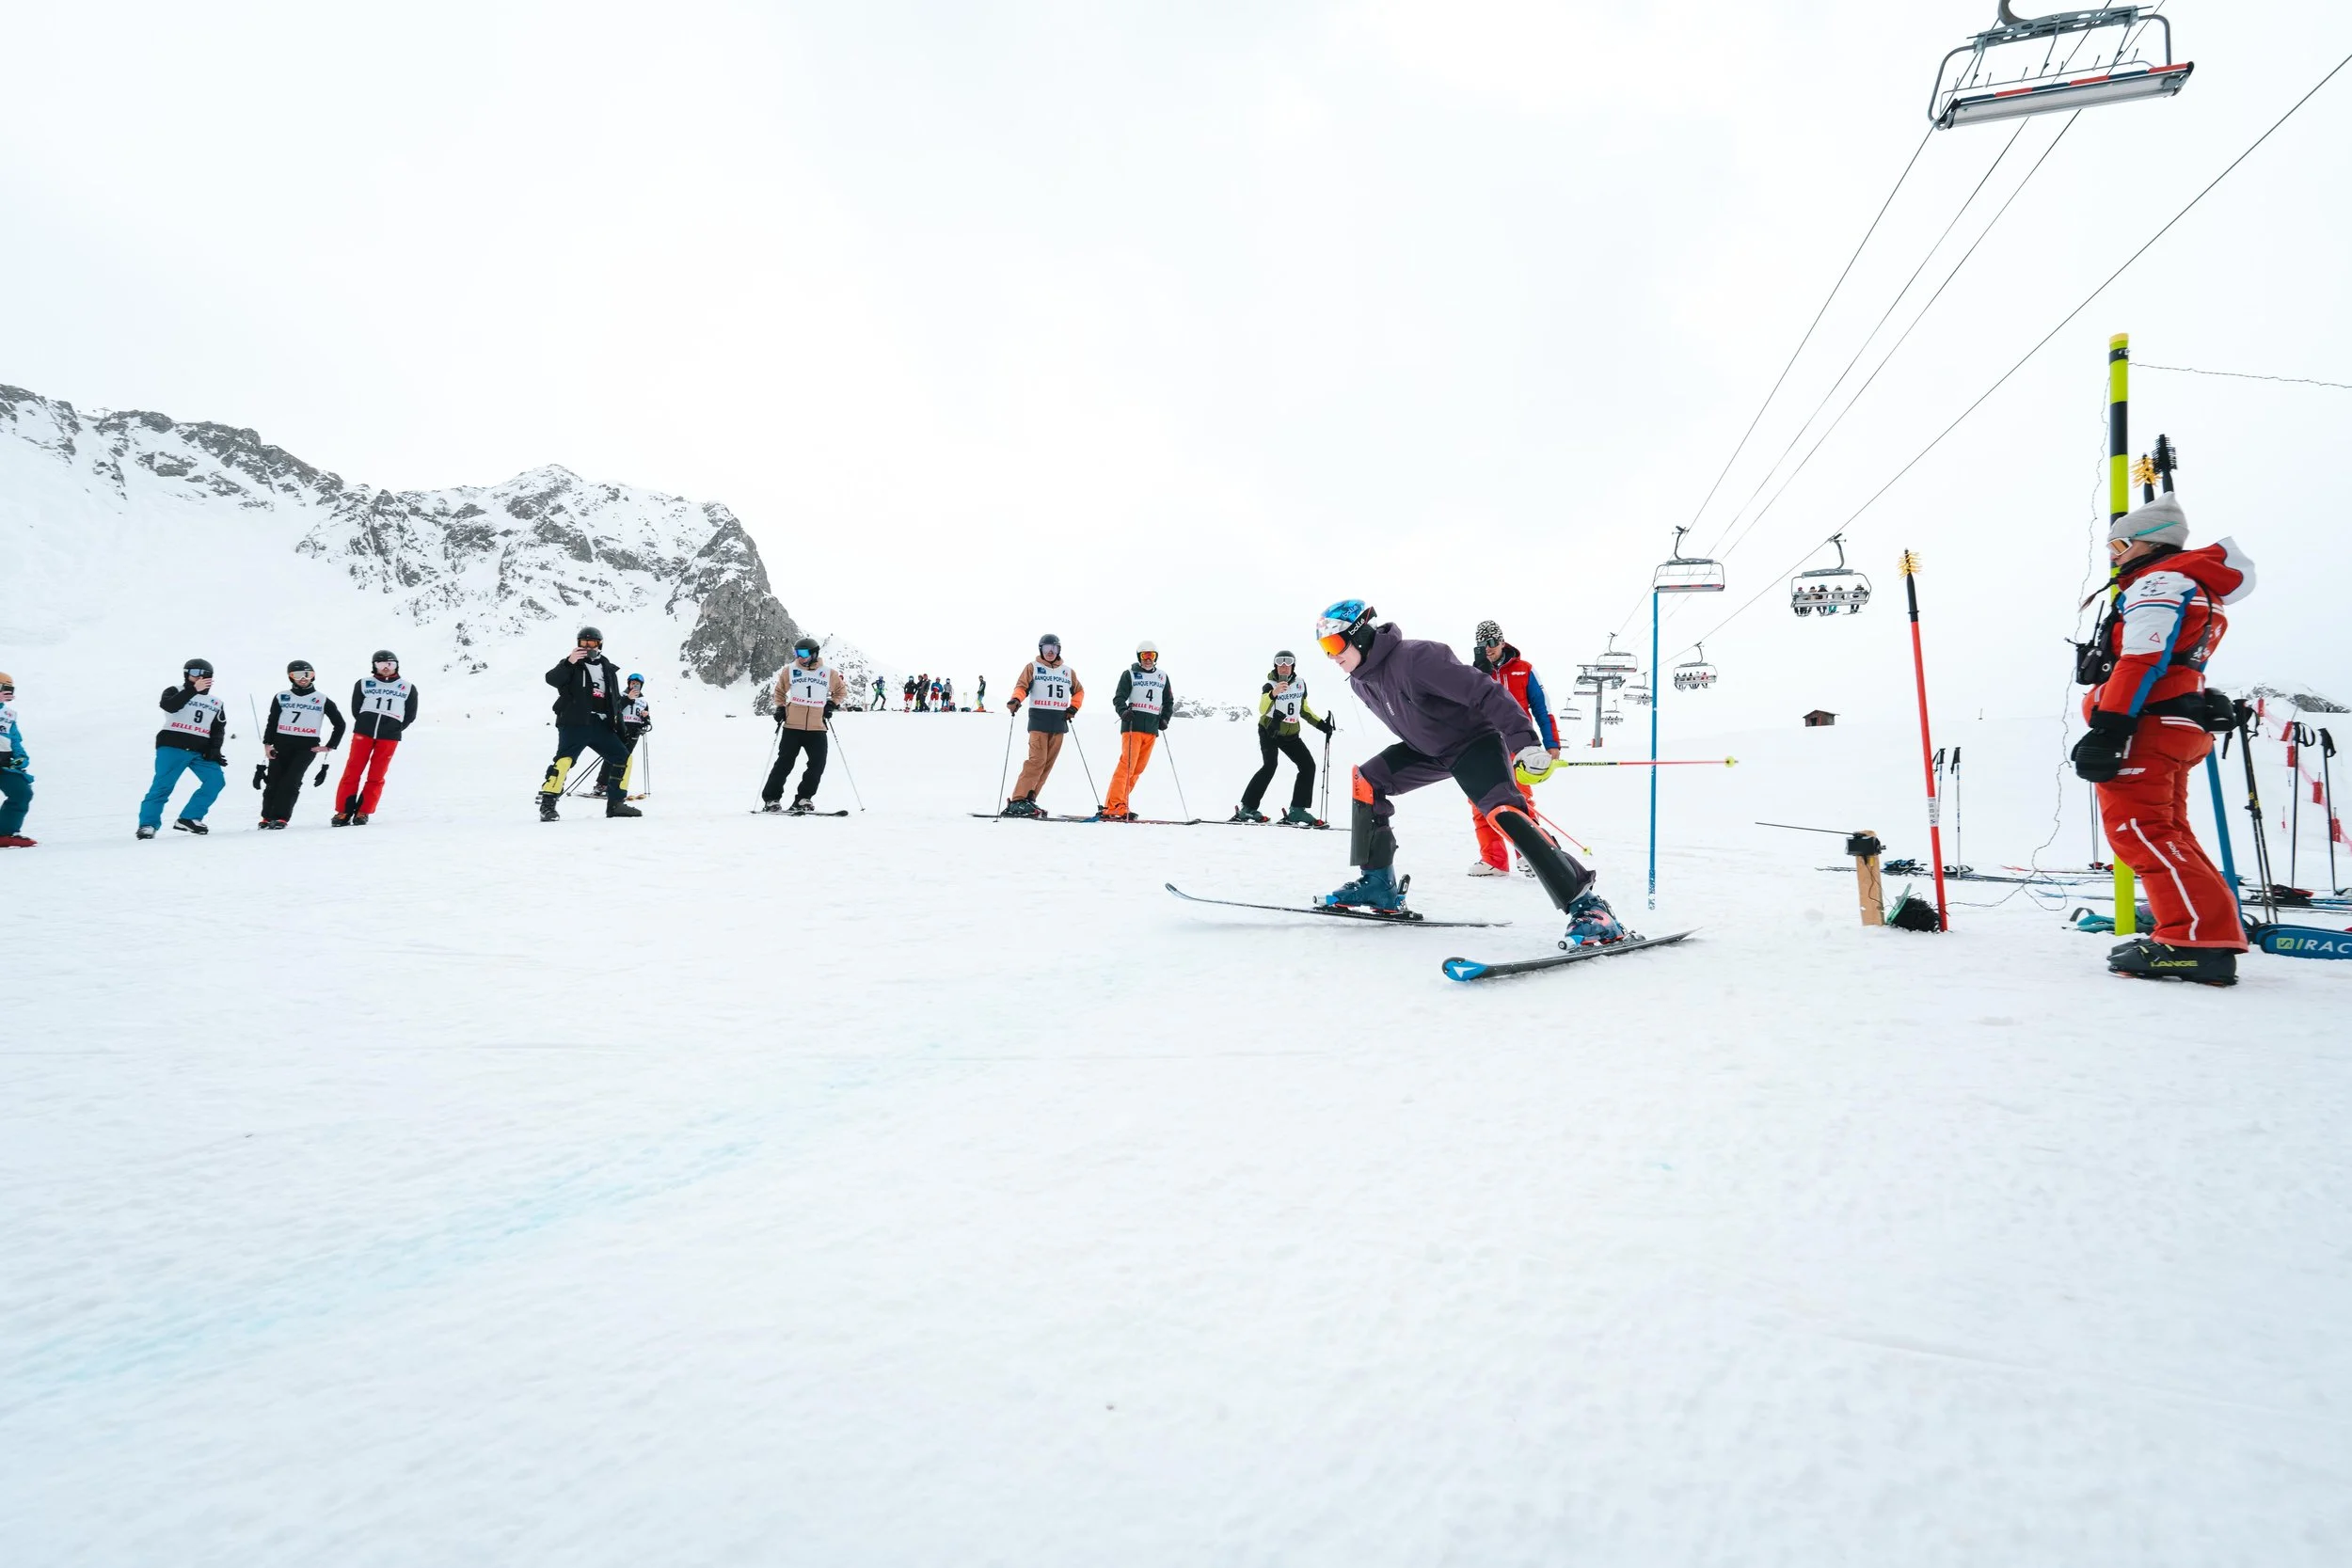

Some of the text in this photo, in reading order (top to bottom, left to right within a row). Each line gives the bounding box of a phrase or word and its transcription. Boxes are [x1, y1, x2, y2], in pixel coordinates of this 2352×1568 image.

[805, 685, 812, 698] 1
[1047, 684, 1064, 699] 15
[1145, 689, 1153, 702] 4
[375, 697, 392, 710] 11
[1287, 702, 1295, 715] 6
[194, 709, 203, 723] 9
[292, 711, 301, 723] 7
[170, 721, 193, 731] BELLE
[2150, 959, 2199, 968] LANGE
